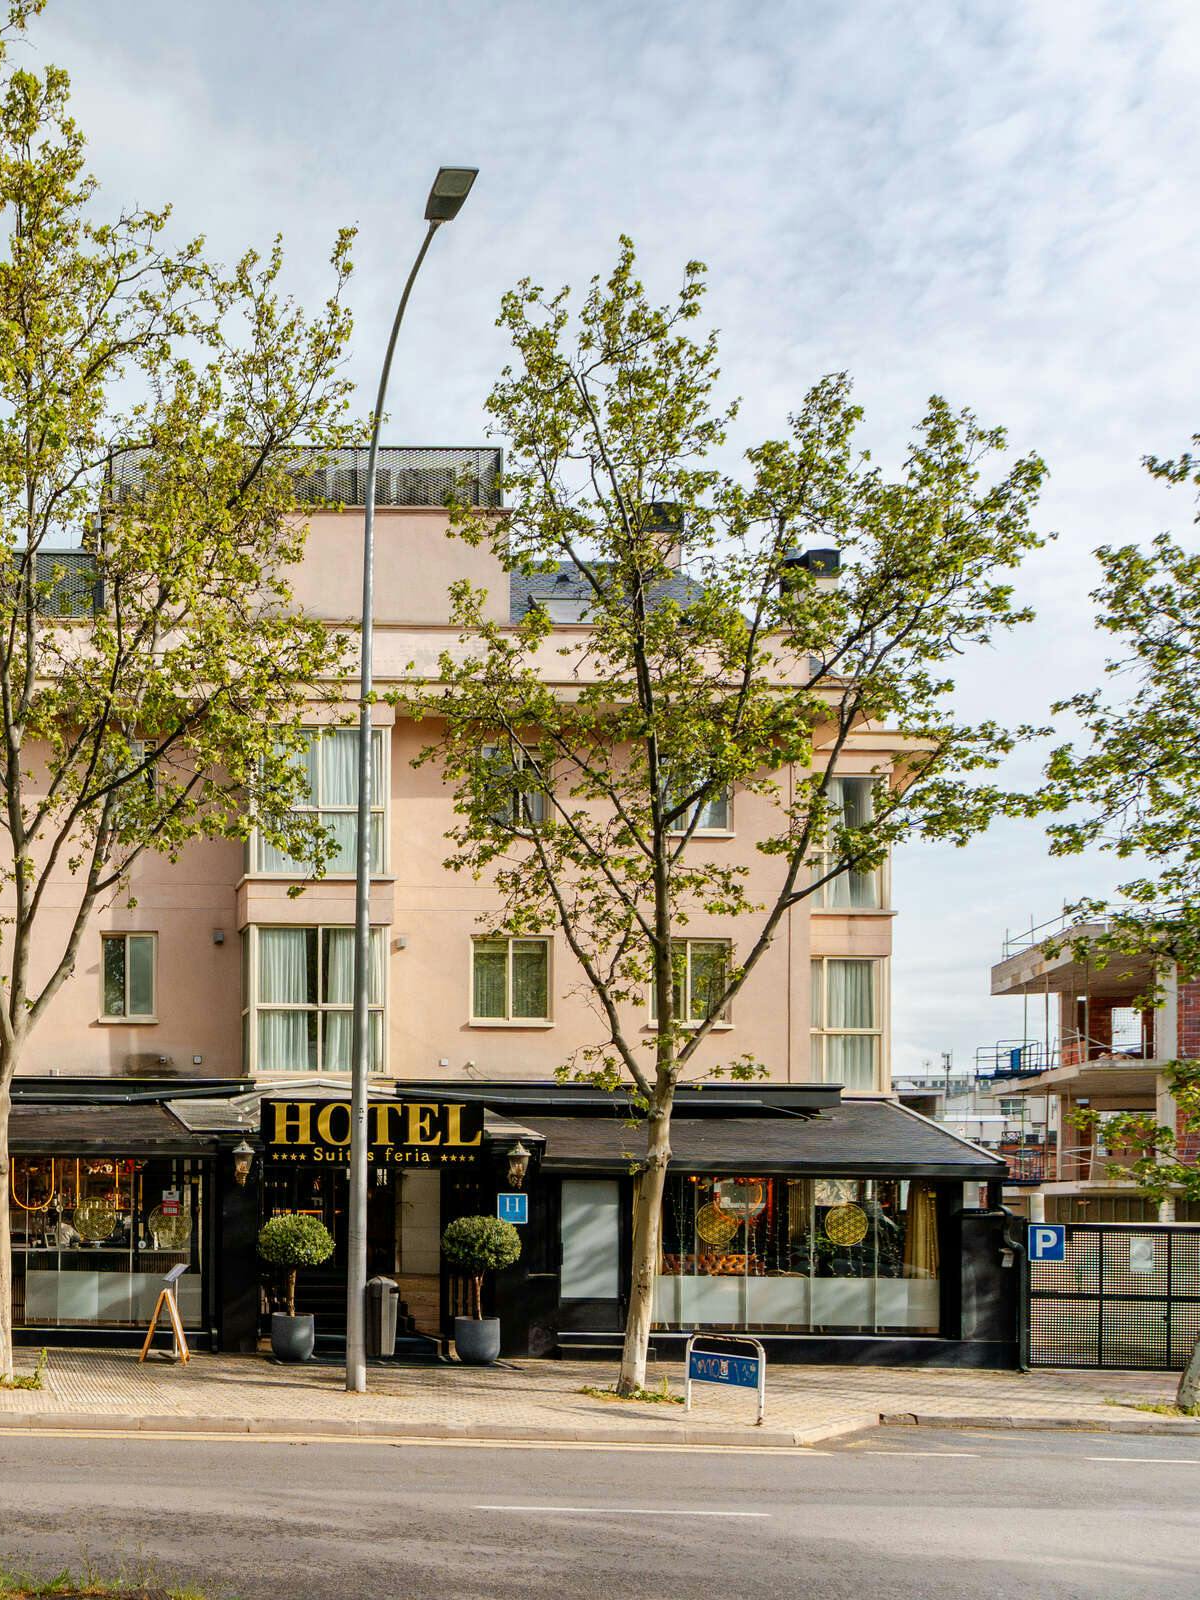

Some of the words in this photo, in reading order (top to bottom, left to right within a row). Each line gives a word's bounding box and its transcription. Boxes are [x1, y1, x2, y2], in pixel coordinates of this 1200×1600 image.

[269, 1102, 482, 1146] HOTEL
[313, 1148, 374, 1162] Suits
[385, 1148, 430, 1162] feria
[504, 1197, 520, 1212] H
[1036, 1229, 1057, 1257] P
